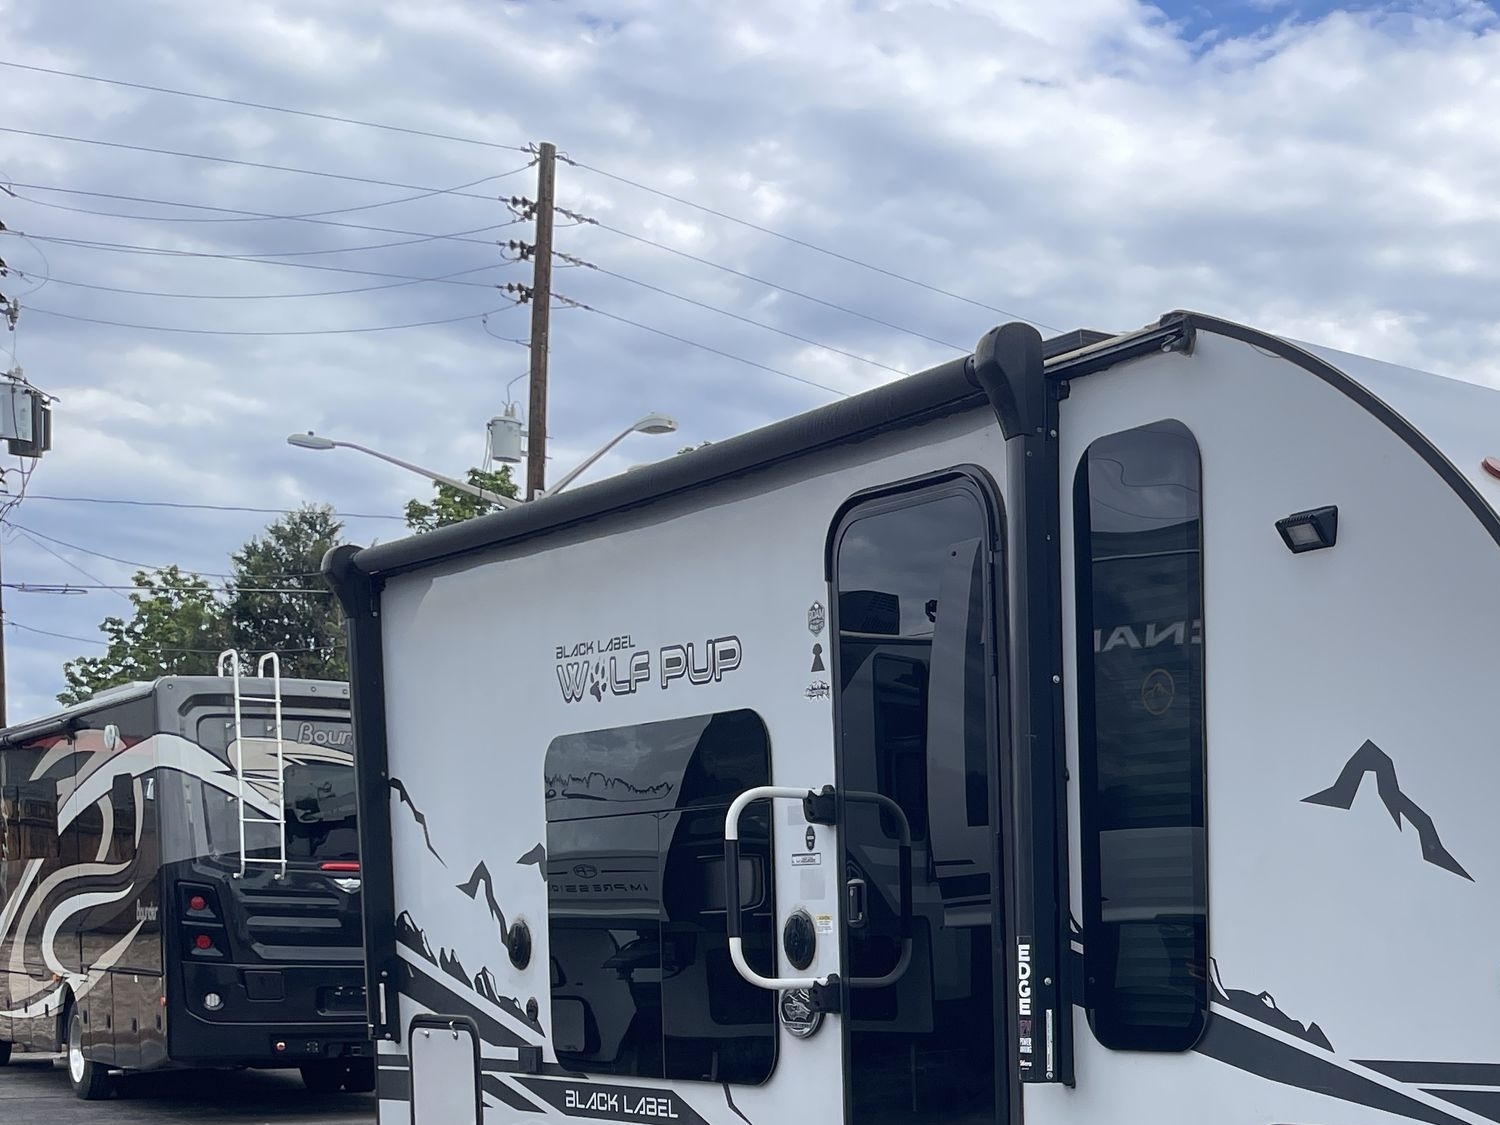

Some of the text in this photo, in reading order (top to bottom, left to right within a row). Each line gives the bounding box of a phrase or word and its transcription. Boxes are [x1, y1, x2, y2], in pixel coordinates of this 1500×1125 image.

[556, 635, 636, 659] BLACK LABEL
[660, 635, 742, 689] PUP
[1018, 944, 1031, 1016] EDGE
[565, 1089, 679, 1118] BLACK LABEL
